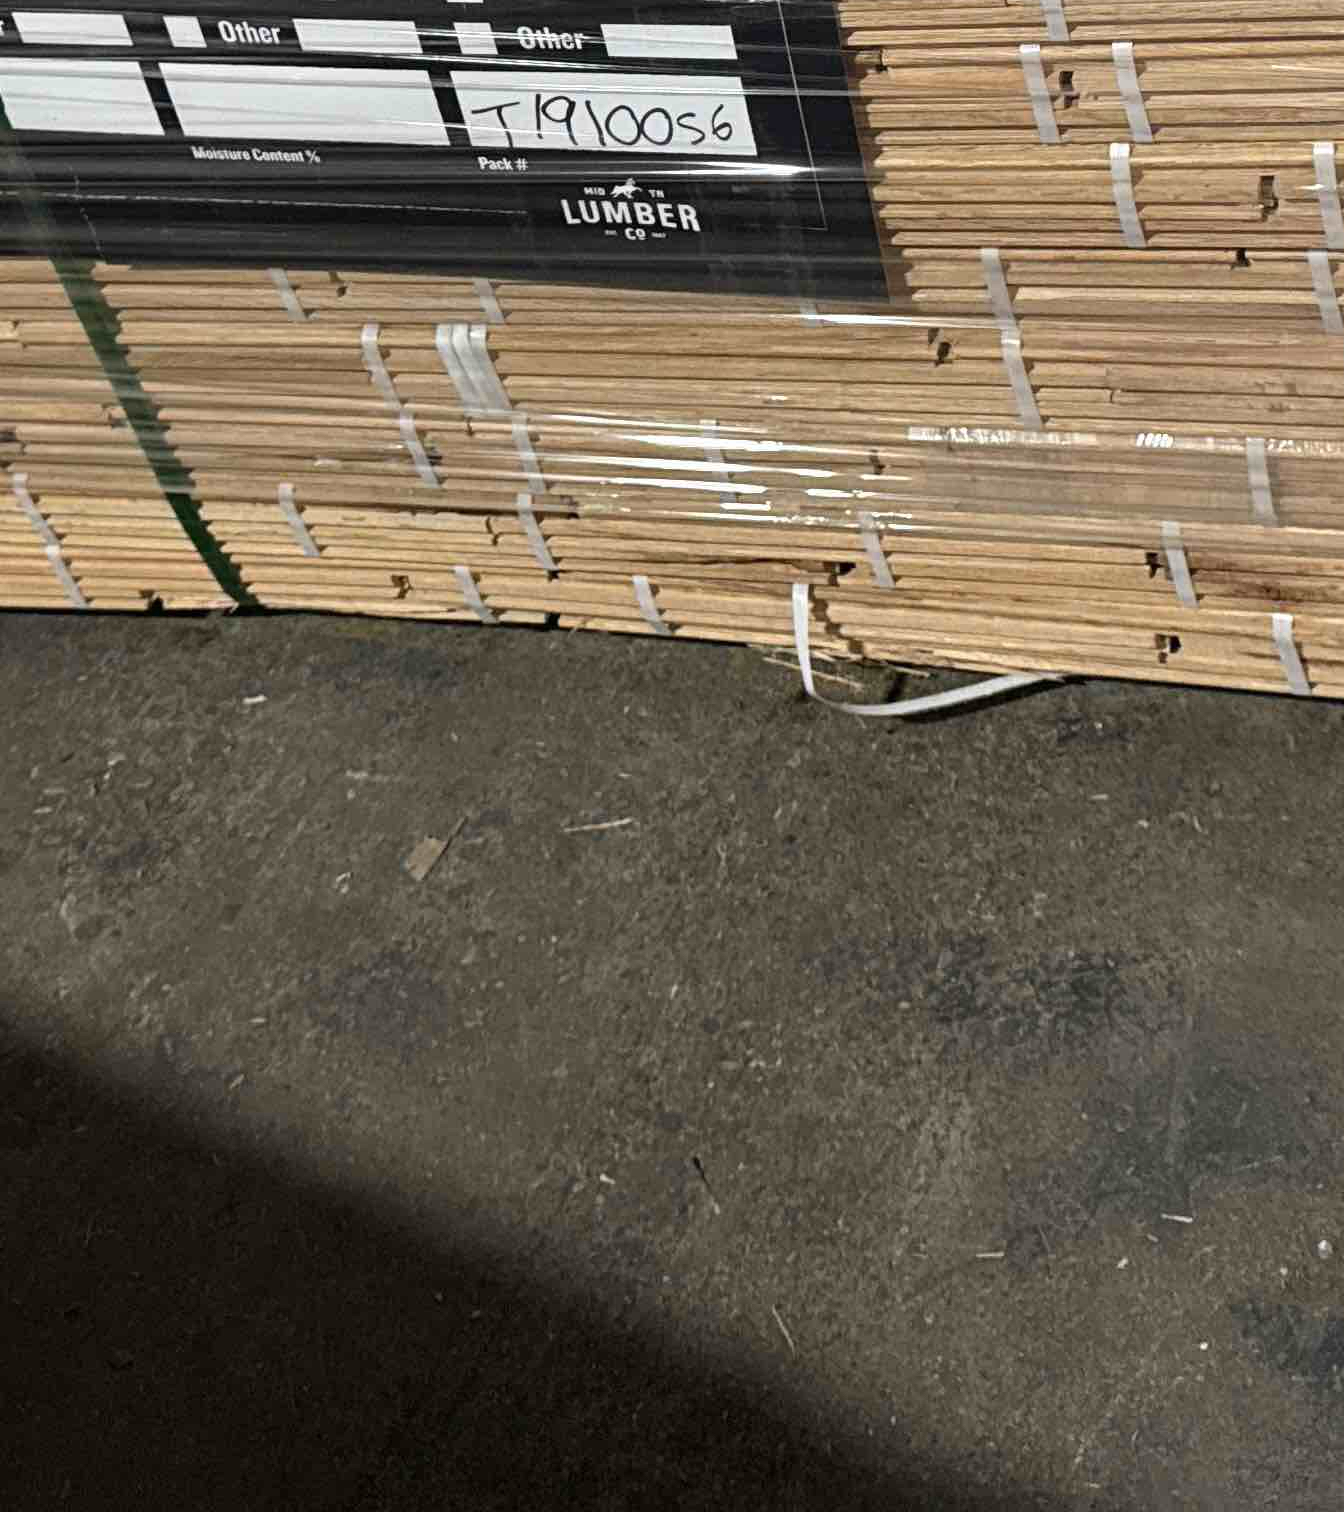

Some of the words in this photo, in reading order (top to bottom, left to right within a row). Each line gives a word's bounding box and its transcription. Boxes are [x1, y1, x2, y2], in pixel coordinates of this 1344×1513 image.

[217, 20, 281, 44] Other
[516, 25, 584, 50] Other
[471, 92, 733, 148] T1910056
[191, 146, 251, 161] Moisture
[251, 148, 305, 162] Content
[305, 149, 321, 164] %
[478, 156, 513, 171] Pack
[516, 159, 528, 171] #
[560, 199, 702, 232] LUMBER
